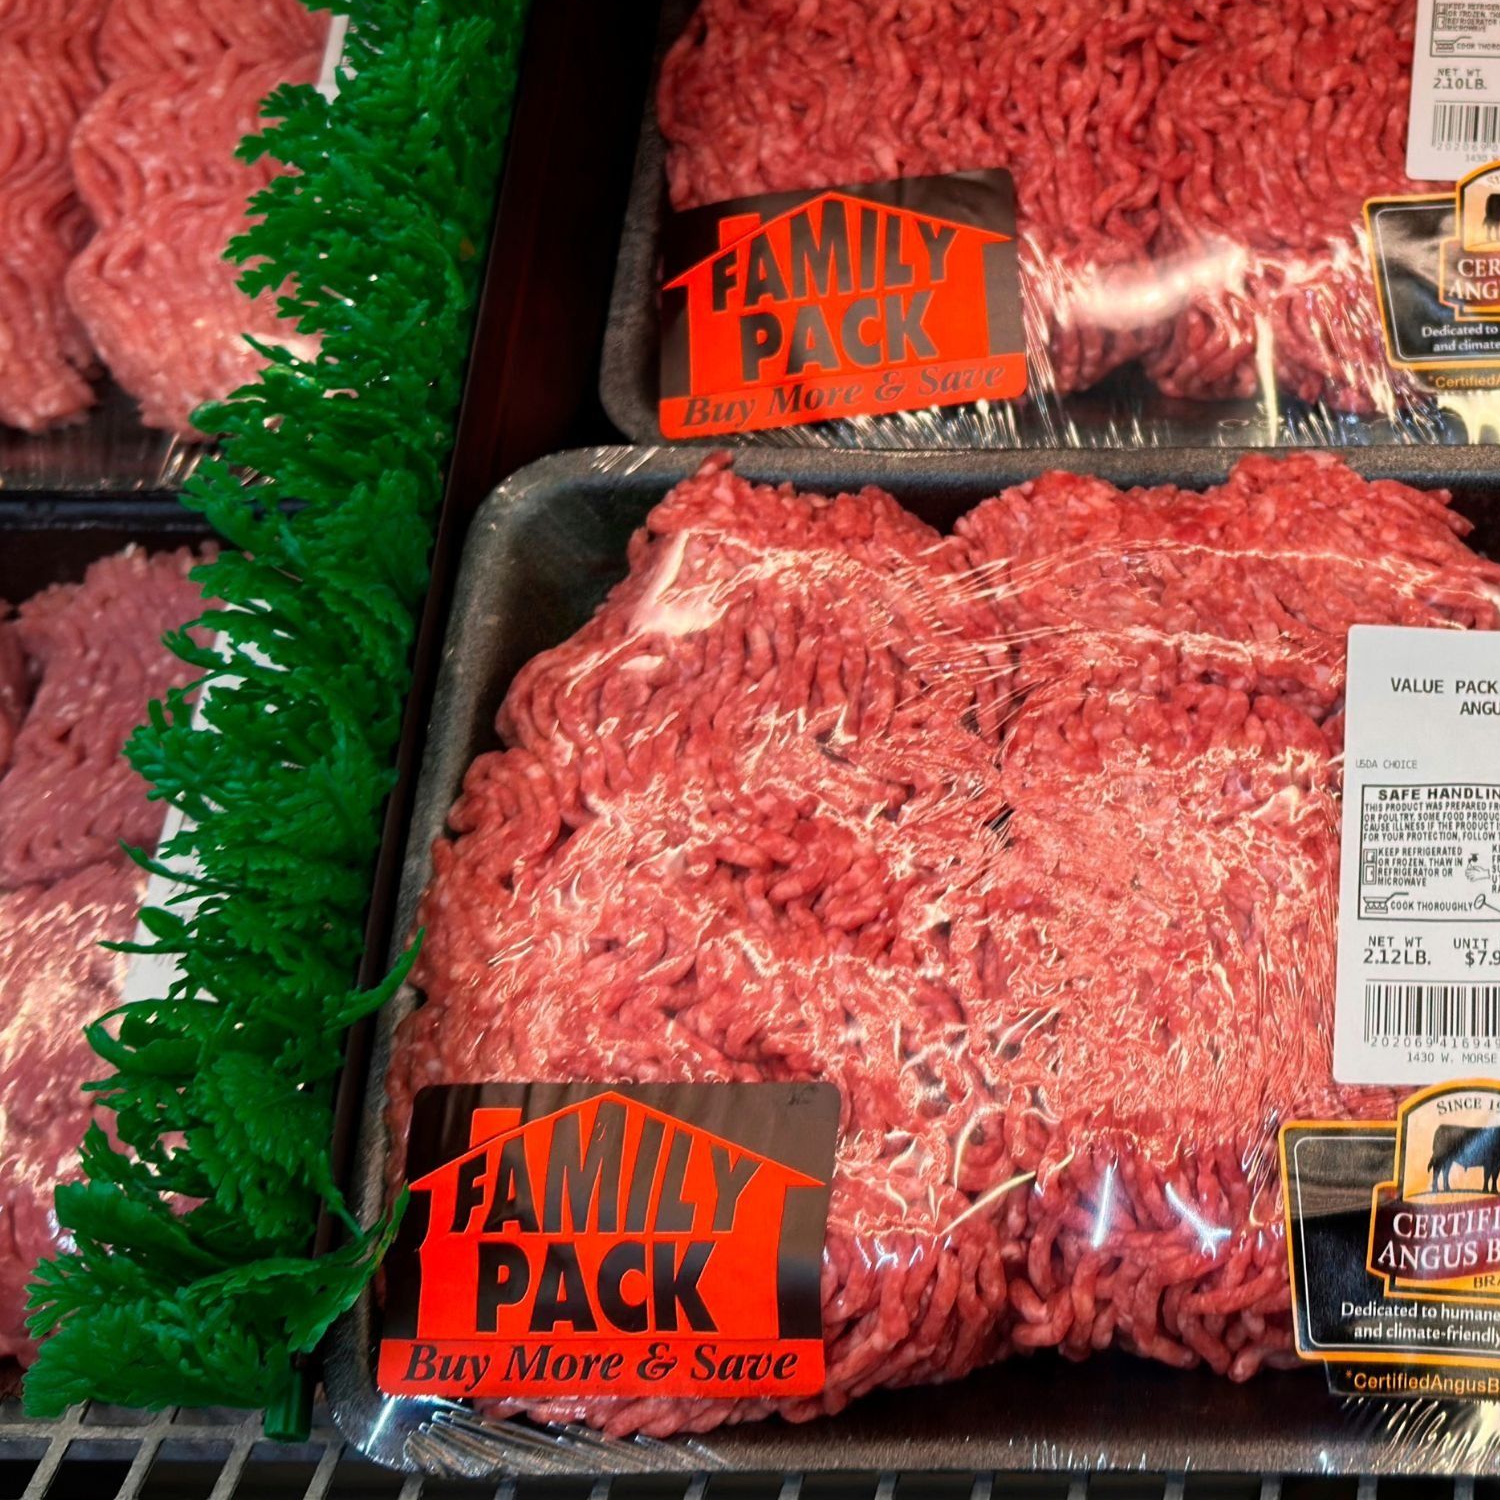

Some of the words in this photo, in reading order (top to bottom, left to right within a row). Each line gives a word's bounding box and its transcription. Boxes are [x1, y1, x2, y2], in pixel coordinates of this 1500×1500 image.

[712, 200, 959, 311] FAMILY
[739, 290, 940, 382] PACK
[682, 396, 756, 428] Buy
[769, 382, 864, 416] More
[874, 372, 906, 400] &
[918, 365, 1006, 396] Save
[1391, 678, 1444, 694] VALUE
[1455, 680, 1498, 694] PACK
[1383, 759, 1418, 770] CHOICE
[1378, 789, 1420, 801] SAFE
[1368, 936, 1394, 948] NET
[1405, 936, 1424, 948] WT
[1452, 938, 1489, 950] UNIT
[1407, 1052, 1435, 1063] 1430
[1439, 1053, 1455, 1063] W.
[1462, 1053, 1498, 1064] MORSE
[1436, 1097, 1482, 1117] SINCE
[449, 1101, 764, 1234] FAMILY
[1378, 1241, 1479, 1270] ANGUS
[476, 1240, 719, 1334] PACK
[1340, 1302, 1418, 1319] Dedicated
[1422, 1304, 1437, 1319] to
[1441, 1303, 1500, 1323] humane
[1354, 1324, 1383, 1339] and
[402, 1344, 490, 1392] Buy
[501, 1344, 624, 1383] More
[637, 1344, 678, 1379] &
[690, 1344, 798, 1381] Save
